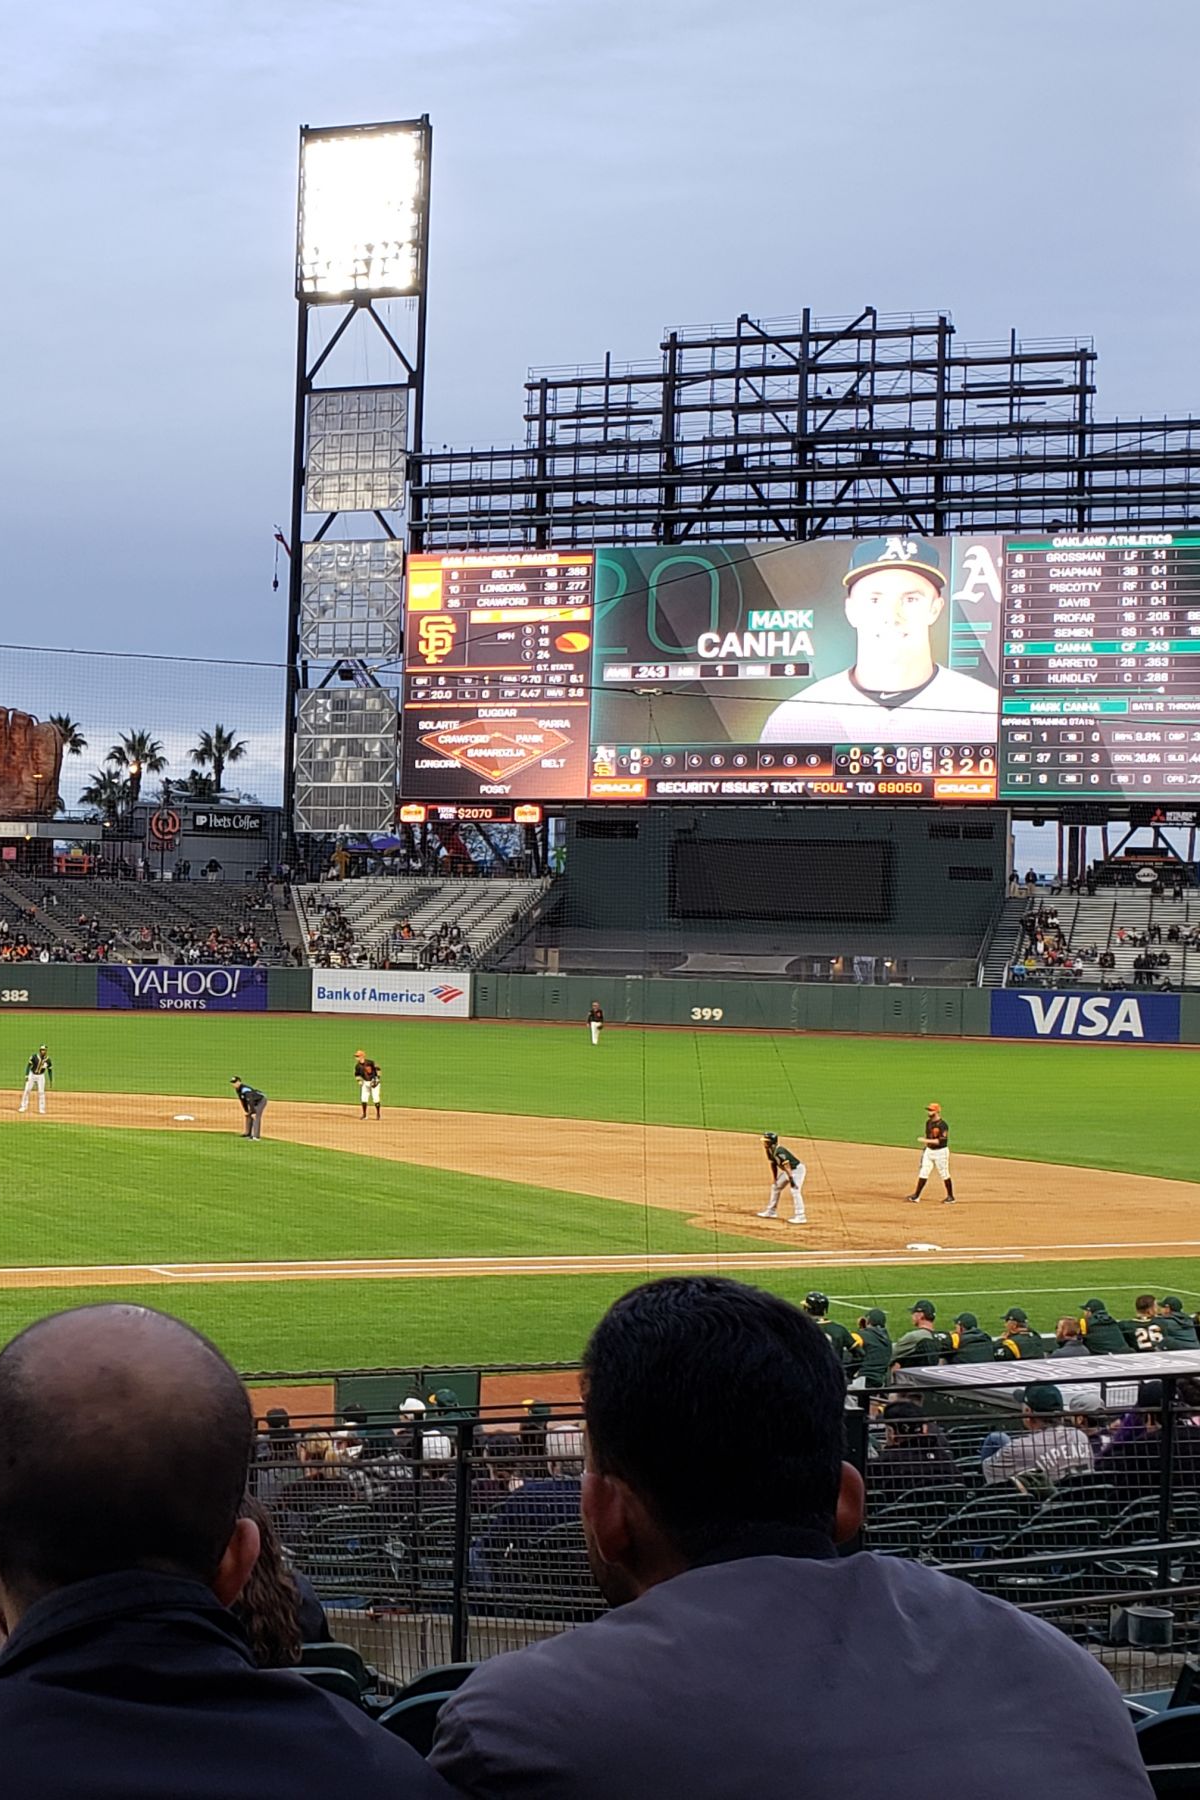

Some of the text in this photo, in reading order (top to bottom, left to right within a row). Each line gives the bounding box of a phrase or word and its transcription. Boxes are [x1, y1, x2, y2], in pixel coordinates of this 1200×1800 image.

[1052, 534, 1172, 548] OAKLAND ATHLETICS
[1046, 552, 1106, 562] GROSSMAN
[1124, 551, 1138, 560] LF
[491, 569, 516, 579] BELT
[1049, 567, 1102, 577] CHAPMAN
[479, 583, 527, 593] LONGORIA
[1049, 582, 1102, 593] PISCOTTY
[1122, 581, 1138, 591] RF
[476, 597, 529, 607] CRAWFORD
[1058, 598, 1091, 607] DAVIS
[1122, 597, 1138, 606] DH
[751, 610, 813, 629] MARK
[1053, 612, 1096, 623] PROFAR
[1054, 628, 1094, 638] SEMIEN
[697, 631, 815, 658] CANHA
[1054, 642, 1093, 653] CANHA
[1048, 658, 1098, 668] BARRETO
[634, 666, 667, 679] .243
[1047, 673, 1132, 683] HUNDLEY C
[1030, 702, 1061, 712] MARK
[1062, 702, 1101, 712] CANHA
[1155, 702, 1164, 712] R
[477, 708, 518, 718] DUGGAR
[418, 719, 571, 730] SOLARTE PARRA
[1002, 718, 1031, 726] SPRING
[1032, 718, 1068, 726] TRAINING
[438, 734, 544, 744] CRAWFORD PANIK
[467, 748, 526, 758] SAMARDZIJA
[1036, 753, 1051, 763] 37
[415, 758, 567, 769] LONGORIA BELT
[939, 758, 994, 775] 3 2 0
[479, 785, 512, 794] POSEY
[656, 782, 721, 794] SECURITY
[721, 782, 768, 794] ISSUE?
[770, 782, 805, 794] TEXT
[807, 781, 854, 794] "FOUL"
[856, 781, 875, 794] TO
[457, 808, 493, 819] $2070
[233, 813, 261, 830] Coffee
[127, 966, 241, 998] YAHOO!
[1, 989, 29, 1002] 382
[316, 986, 426, 1004] Bank of America
[159, 998, 206, 1010] SPORTS
[690, 1007, 723, 1021] 399
[1018, 995, 1145, 1039] VISA
[1134, 1324, 1163, 1347] 26
